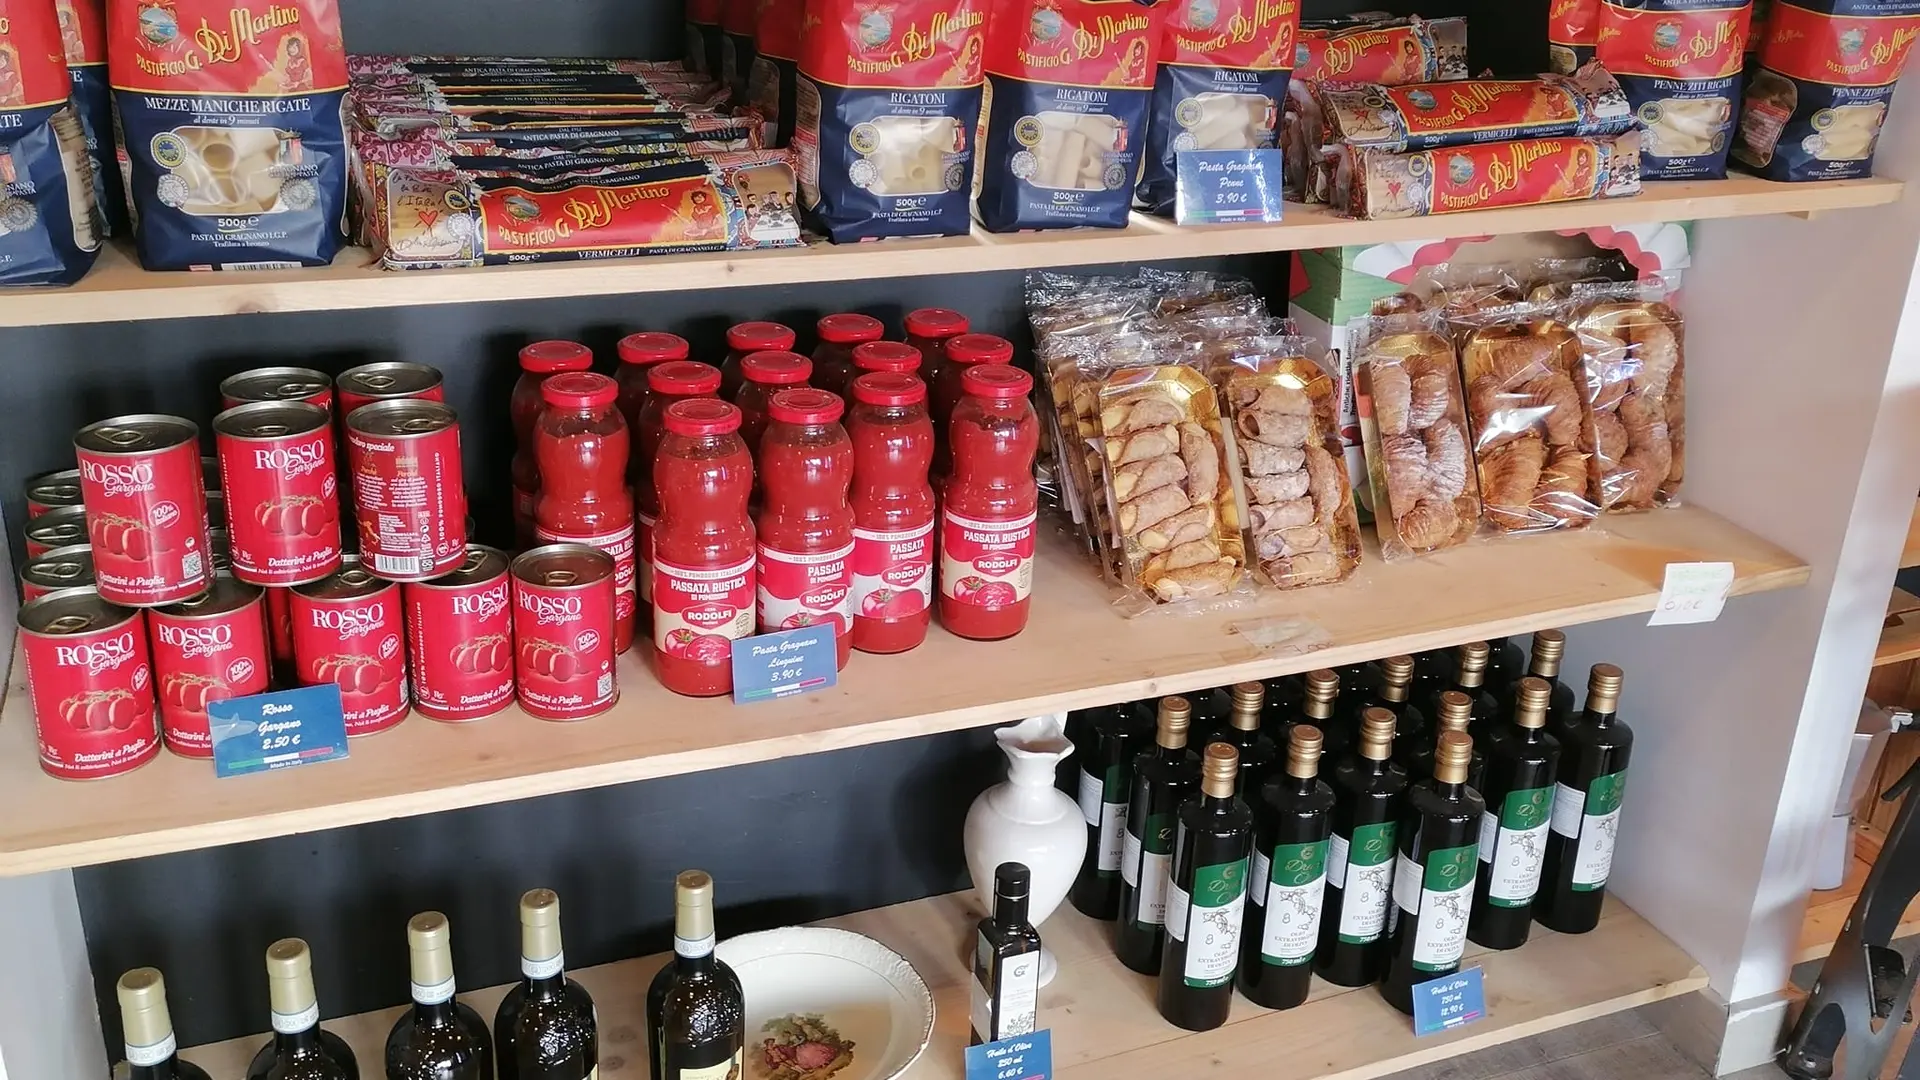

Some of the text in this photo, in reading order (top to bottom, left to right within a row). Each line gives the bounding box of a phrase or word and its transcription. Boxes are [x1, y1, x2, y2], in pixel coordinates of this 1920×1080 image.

[136, 52, 186, 77] PASTIFICIO
[184, 54, 203, 71] G.
[222, 5, 299, 62] Martino
[848, 56, 891, 75] PASTIFICIO
[890, 52, 905, 69] G.
[920, 9, 984, 58] Martino
[1017, 49, 1059, 69] PASTIFICIO
[1059, 47, 1073, 65] G.
[1089, 13, 1149, 58] Martino
[1176, 33, 1216, 53] PASTIFICIO
[1214, 71, 1259, 83] RIGATONI
[890, 92, 945, 105] RIGATONI
[1056, 89, 1108, 102] RIGATONI
[144, 97, 311, 113] MEZZE MANICHE RIGATE
[228, 115, 236, 126] 9
[523, 134, 549, 142] ANTICA
[550, 133, 570, 141] PASTA
[579, 130, 620, 139] GRAGNANO
[518, 162, 544, 171] ANTICA
[544, 160, 563, 170] PASTA
[574, 157, 615, 166] GRAGNANO
[1199, 161, 1224, 173] Pasta
[1219, 177, 1244, 188] Penne
[1440, 192, 1479, 208] PASTIFICIO
[1479, 182, 1491, 200] G.
[1503, 141, 1562, 190] Martino
[896, 199, 917, 209] 500g
[1053, 192, 1074, 203] 500g
[1215, 192, 1239, 204] 3.90
[217, 218, 247, 229] 500g
[499, 224, 556, 247] PASTIFICIO
[555, 217, 573, 238] G.
[590, 186, 670, 228] Martino
[191, 233, 214, 241] PASTA
[215, 233, 224, 241] DI
[225, 232, 270, 241] GRAGNANO
[509, 248, 640, 262] 500g VERMICELLI
[254, 440, 325, 471] ROSSO
[366, 442, 395, 453] speciale
[82, 459, 153, 485] ROSSO
[284, 458, 326, 481] Gargano
[105, 476, 156, 497] Gargano
[153, 505, 174, 520] 100%
[964, 528, 1030, 544] PASSATA RUSTICA
[890, 539, 925, 553] PASSATA
[268, 554, 305, 567] Datterini
[313, 546, 333, 561] Puglia
[978, 560, 1018, 568] RODOLFI
[808, 560, 845, 576] PASSATA
[888, 567, 923, 581] RODOLFI
[99, 571, 129, 586] Datterini
[136, 576, 165, 588] Puglia
[670, 575, 746, 593] PASSATA RUSTICA
[453, 581, 509, 615] ROSSO
[519, 588, 582, 615] ROSSO
[806, 589, 845, 604] RODOLFI
[311, 602, 384, 629] ROSSO
[536, 607, 582, 626] Gargano
[688, 609, 732, 621] RODOLFI
[158, 623, 233, 646] ROSSO
[339, 617, 384, 640] Gargano
[56, 631, 135, 667] ROSSO
[183, 640, 234, 659] Gargano
[752, 639, 818, 656] Pasta Gragnano
[89, 649, 135, 676] Gargano
[230, 661, 249, 675] 100%
[768, 655, 805, 668] Linguine
[771, 669, 794, 682] 3.90
[460, 693, 493, 704] Datterini
[524, 688, 550, 703] Datterini
[558, 694, 582, 706] Puglia
[262, 703, 293, 716] Rosso
[366, 704, 389, 719] Puglia
[172, 727, 201, 741] Datterini
[258, 720, 302, 736] Gargano
[262, 734, 301, 750] 2.50 €
[75, 749, 114, 763] Datterini
[122, 739, 146, 754] Puglia
